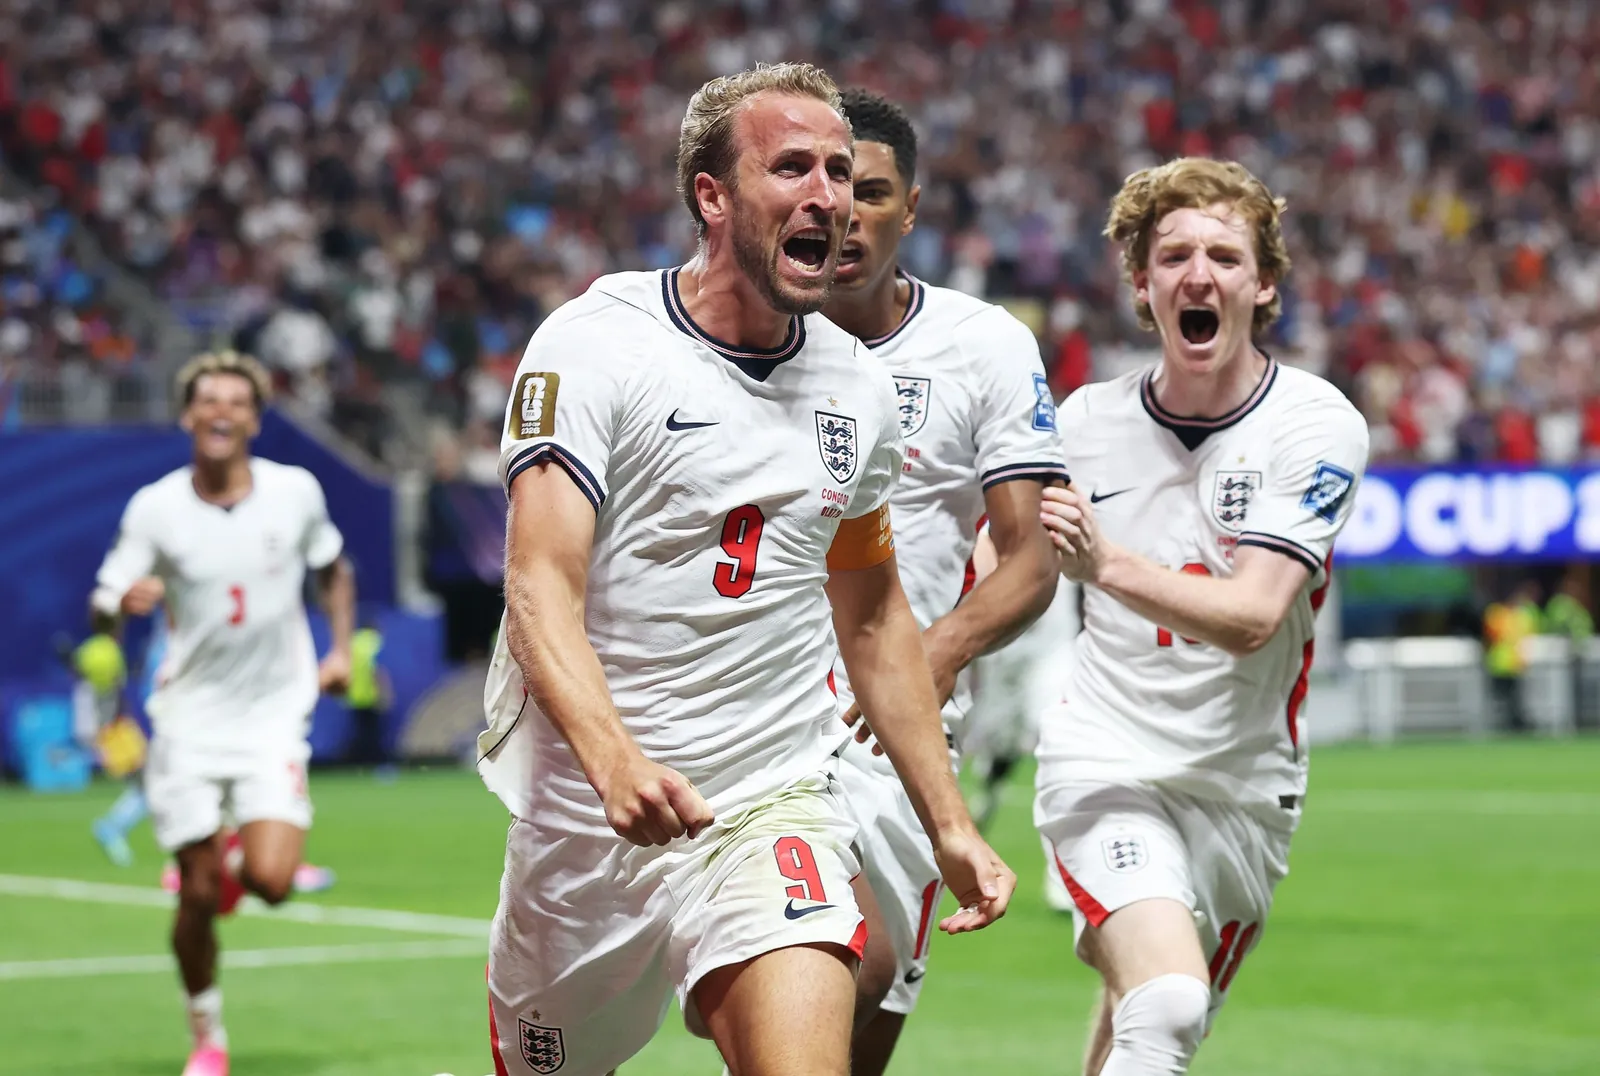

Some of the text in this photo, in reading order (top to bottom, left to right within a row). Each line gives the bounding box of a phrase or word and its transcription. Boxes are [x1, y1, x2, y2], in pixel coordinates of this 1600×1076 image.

[521, 427, 540, 435] 2026
[713, 503, 765, 599] 9
[1405, 472, 1574, 555] CUP
[773, 836, 827, 903] 9
[913, 879, 943, 960] 1
